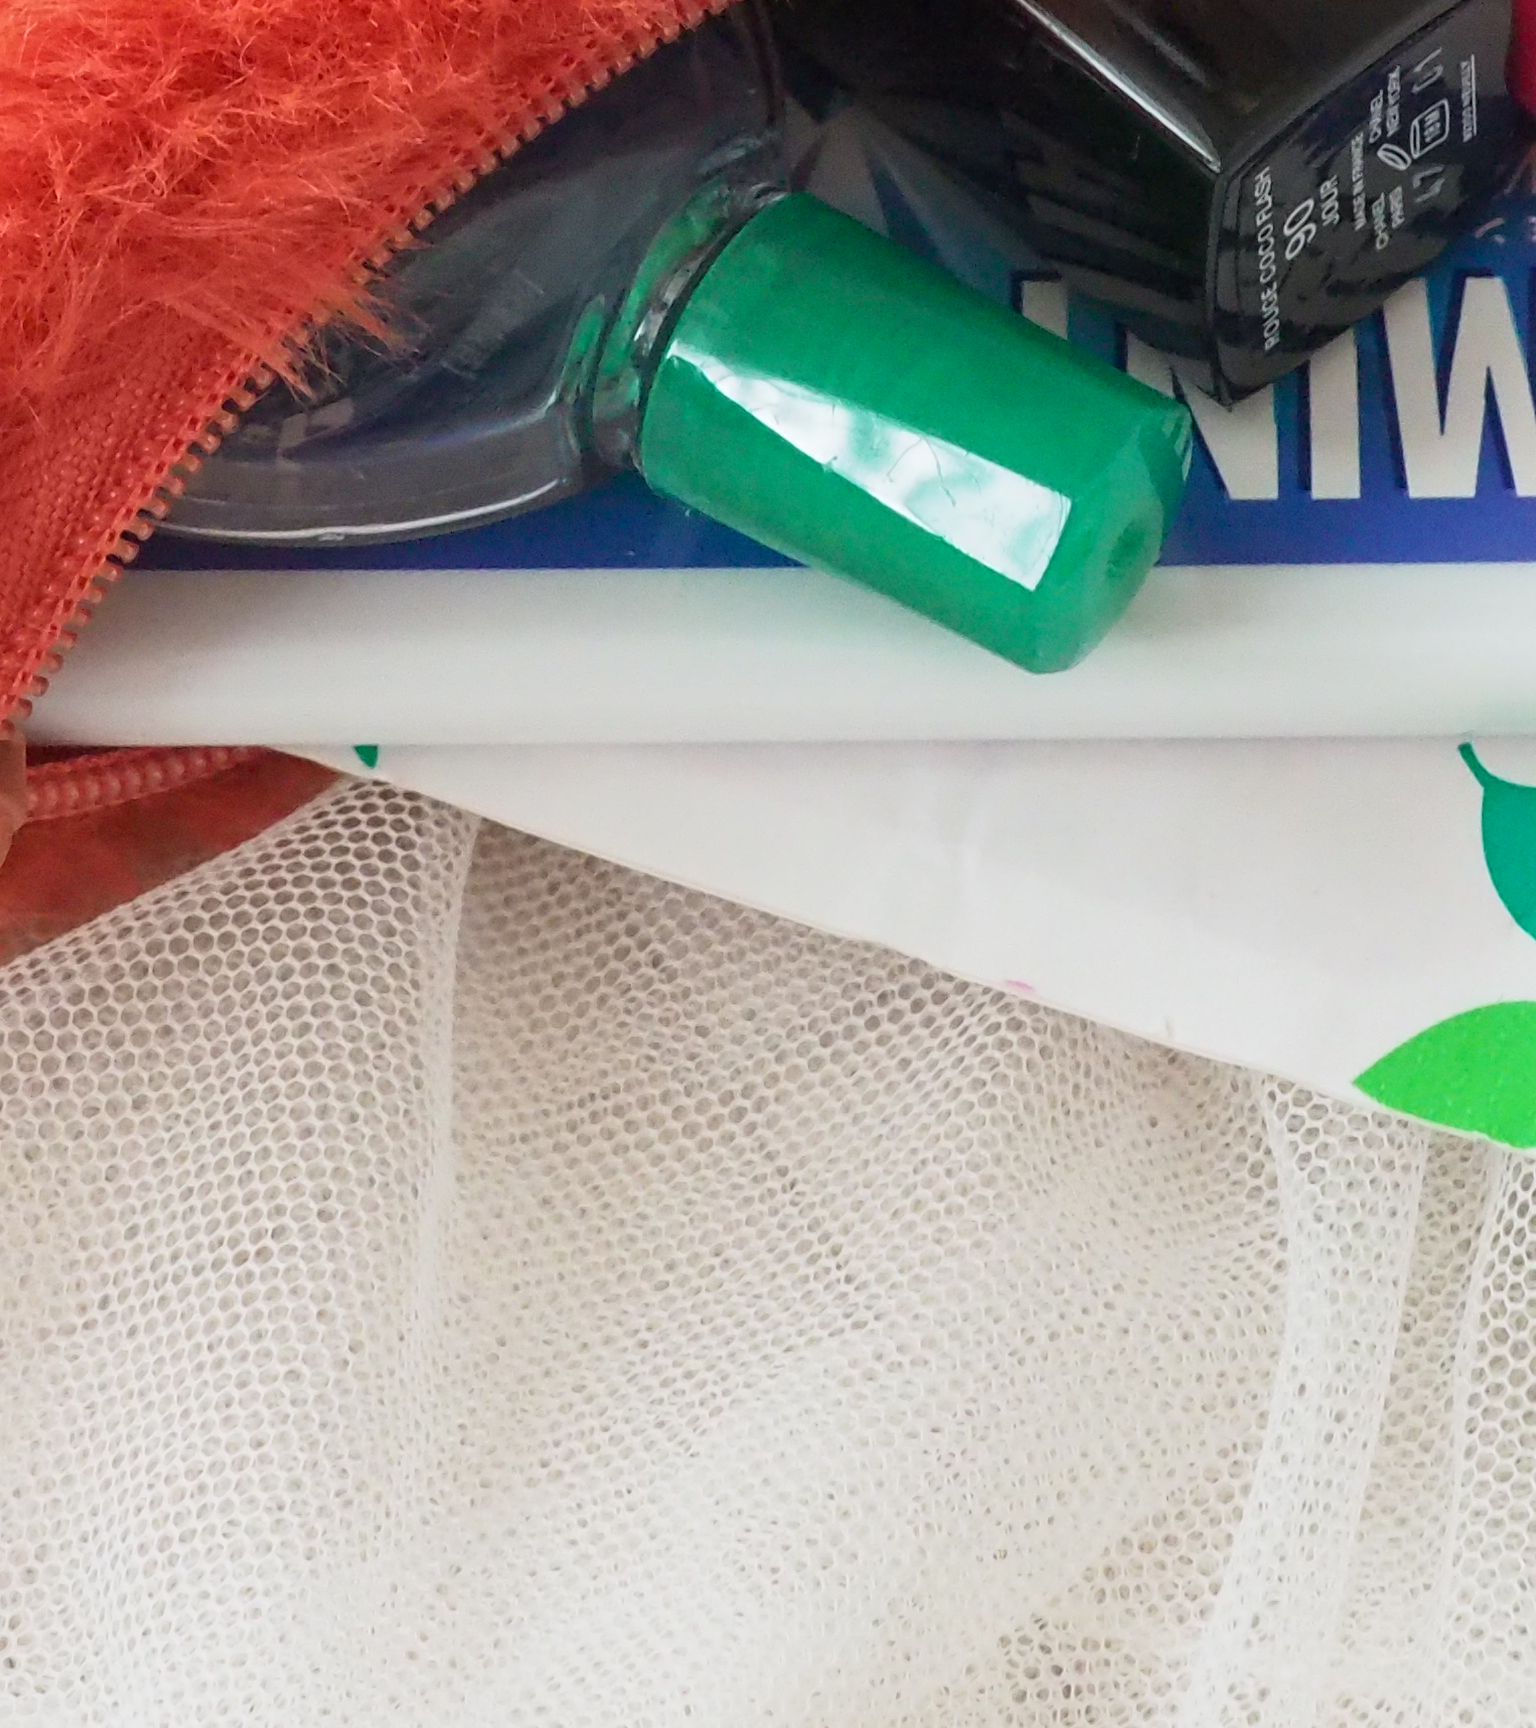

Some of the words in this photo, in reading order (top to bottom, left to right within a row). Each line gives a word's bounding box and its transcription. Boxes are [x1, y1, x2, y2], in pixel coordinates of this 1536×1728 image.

[1350, 131, 1364, 179] FRANCE
[1254, 166, 1273, 227] FLASH
[1319, 174, 1340, 227] JOUR
[1353, 194, 1367, 231] MADE
[1257, 223, 1276, 283] COCO
[1283, 198, 1316, 261] 90
[1260, 281, 1281, 352] ROUGE
